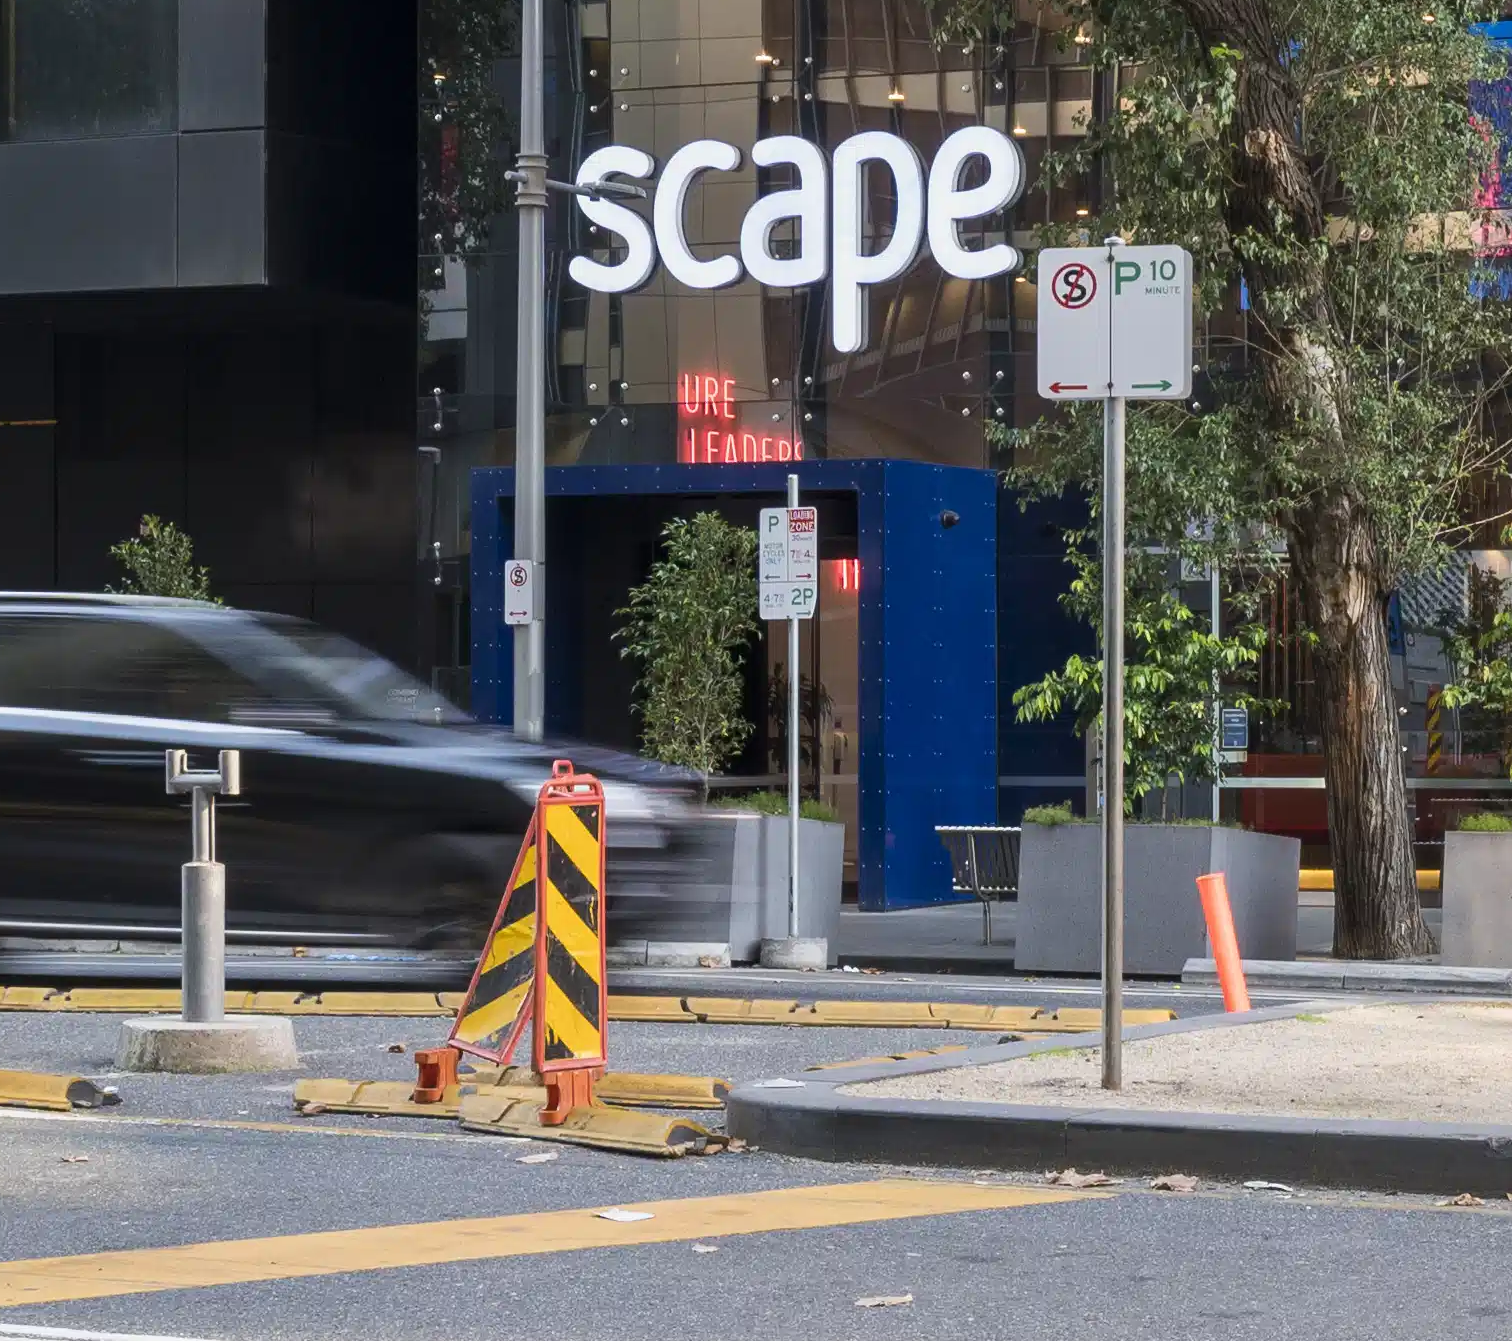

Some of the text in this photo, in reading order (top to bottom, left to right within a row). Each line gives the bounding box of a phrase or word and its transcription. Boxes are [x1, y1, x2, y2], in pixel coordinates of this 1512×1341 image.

[569, 125, 1024, 353] scape
[1115, 259, 1176, 295] P 10
[1145, 285, 1180, 294] MINUTE
[684, 373, 736, 418] URE
[769, 516, 779, 533] P
[790, 522, 814, 532] ZONE
[791, 588, 814, 605] 2P
